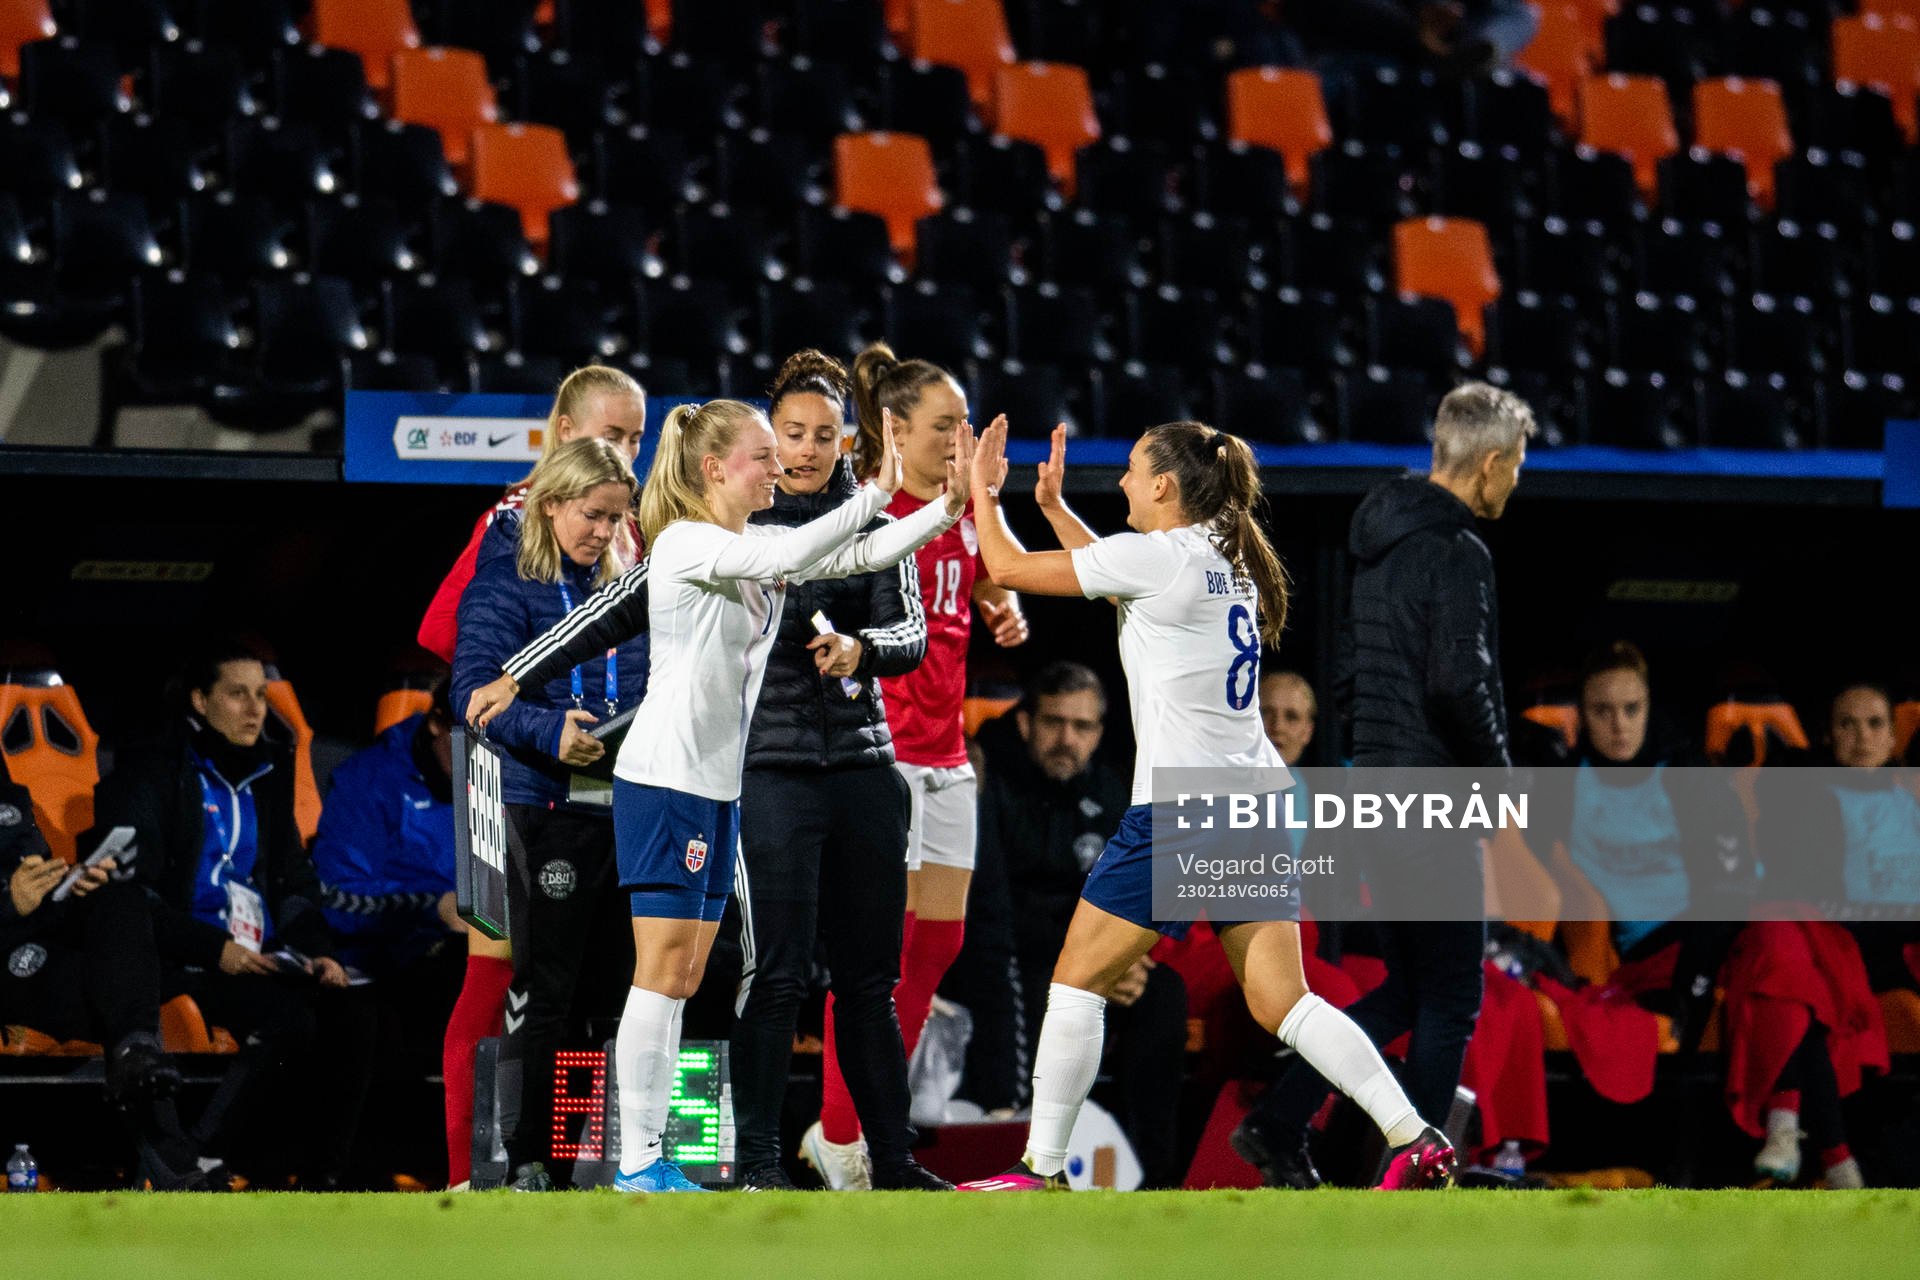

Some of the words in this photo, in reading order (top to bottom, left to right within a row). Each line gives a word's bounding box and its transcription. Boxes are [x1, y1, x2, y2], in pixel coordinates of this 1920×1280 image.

[933, 560, 961, 615] 19
[1205, 570, 1230, 595] BØE
[1226, 604, 1260, 711] 8
[551, 1051, 606, 1159] 8
[671, 1051, 719, 1163] 5
